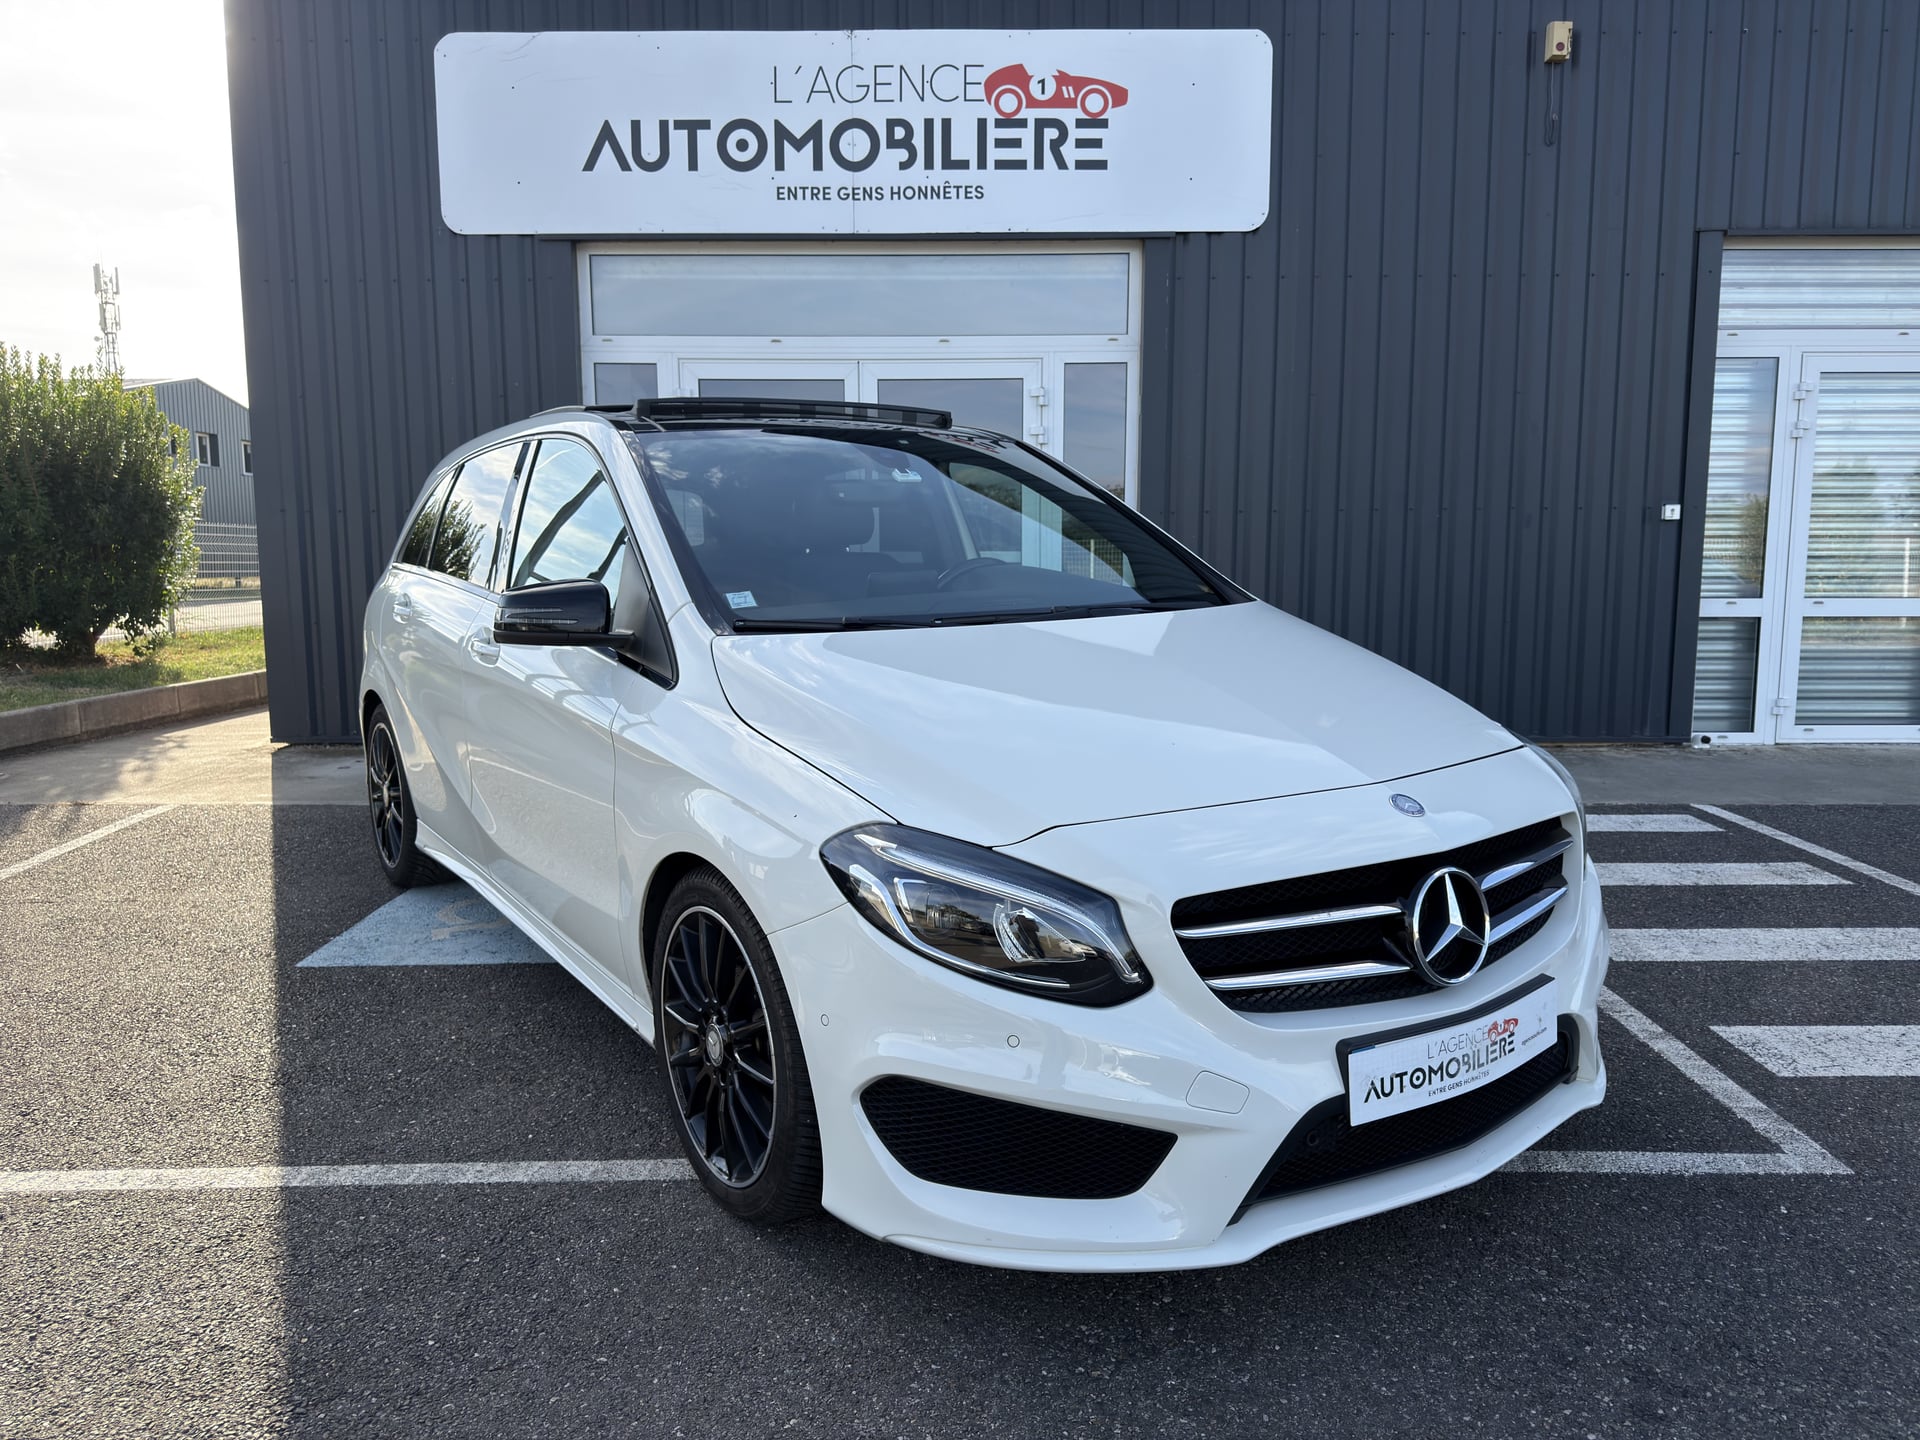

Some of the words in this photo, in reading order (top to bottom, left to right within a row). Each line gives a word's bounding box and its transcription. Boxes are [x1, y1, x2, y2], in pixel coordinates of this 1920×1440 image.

[1036, 77, 1047, 96] 1
[581, 117, 1109, 173] AUTOMOBILIERE
[775, 185, 832, 201] ENTRE
[837, 185, 885, 201] GENS
[890, 180, 985, 201] HONNÊTES
[1364, 1031, 1515, 1104] AUTOMOBILIERE
[1428, 1084, 1447, 1097] ENTRE
[1447, 1080, 1463, 1092] GENS
